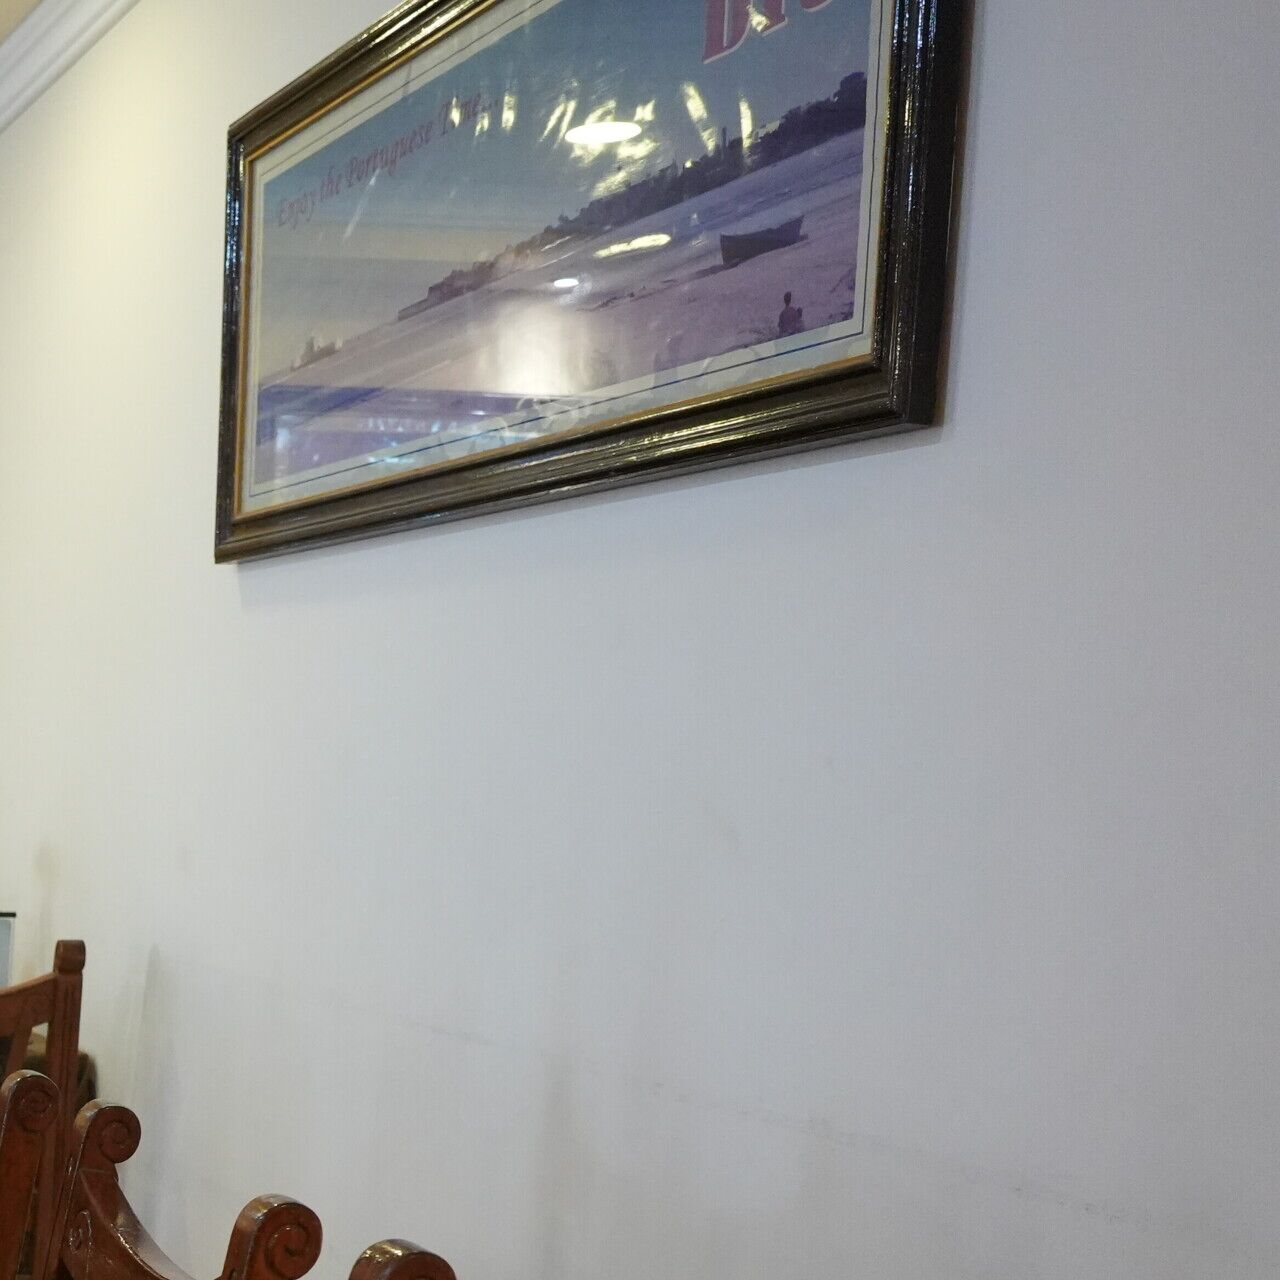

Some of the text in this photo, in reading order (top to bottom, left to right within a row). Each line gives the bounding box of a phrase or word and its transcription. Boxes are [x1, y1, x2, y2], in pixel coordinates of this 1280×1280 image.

[278, 192, 316, 231] Enjoy
[320, 164, 342, 201] the
[344, 121, 433, 188] Portuguese
